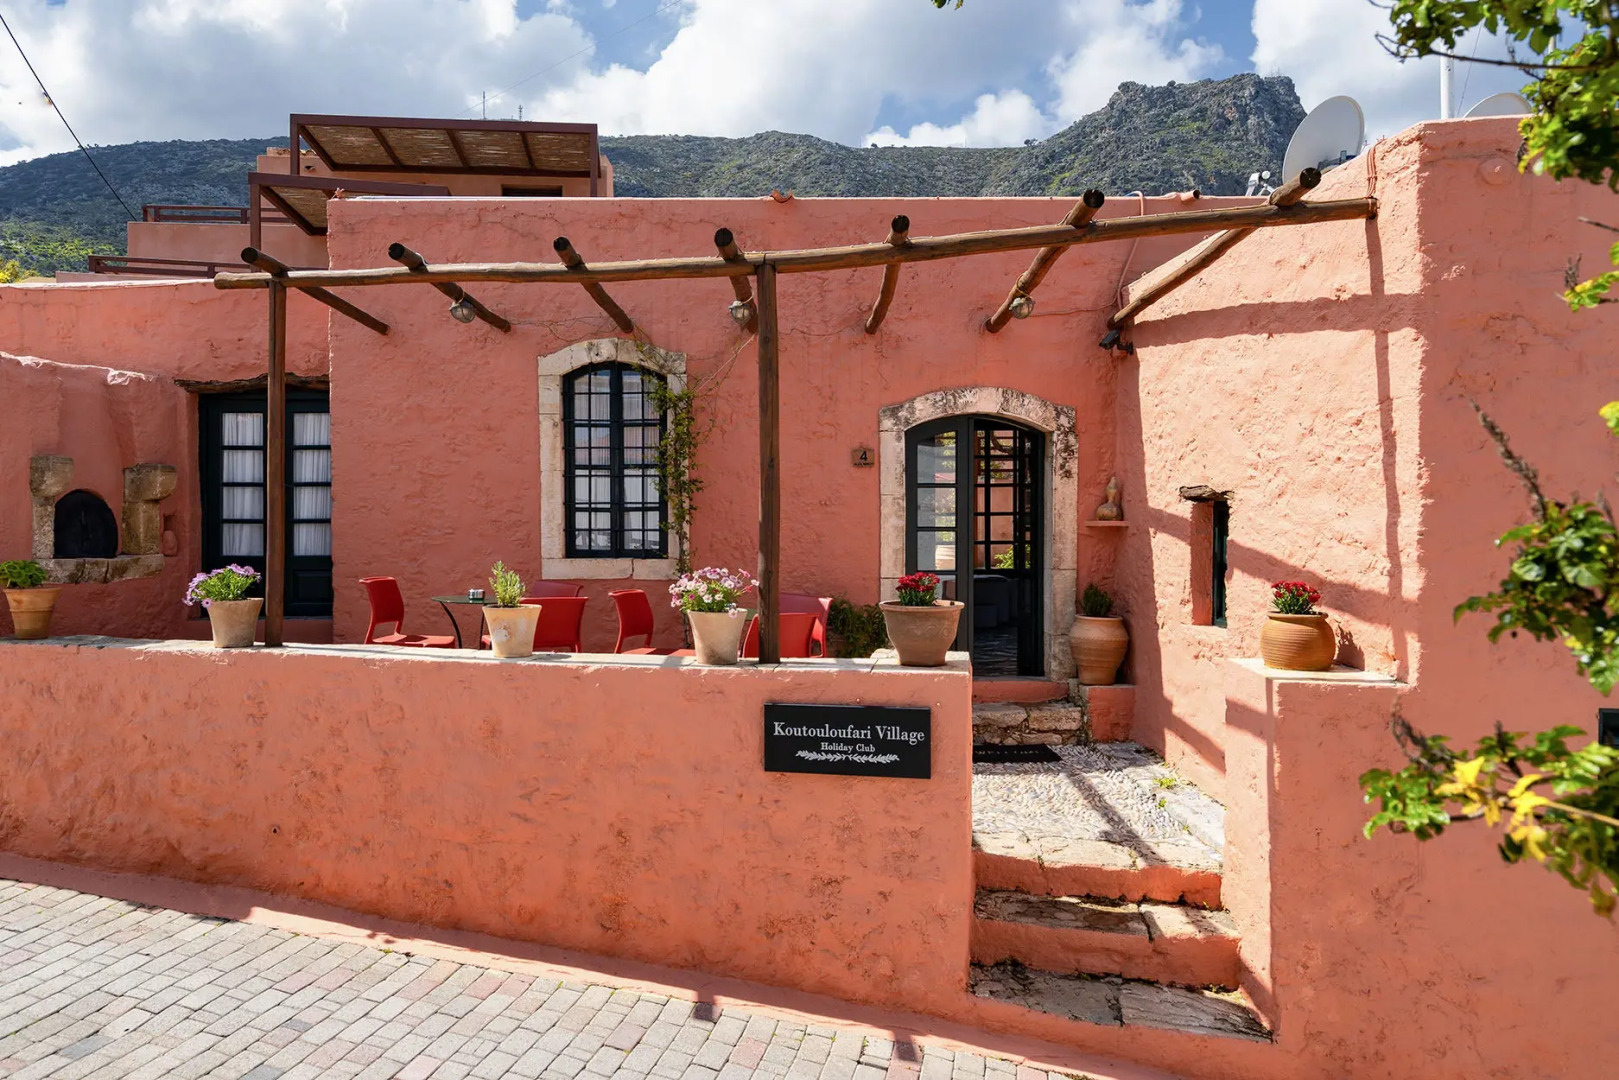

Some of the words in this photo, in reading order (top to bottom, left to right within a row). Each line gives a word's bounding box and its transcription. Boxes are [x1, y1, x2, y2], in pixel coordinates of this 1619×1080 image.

[860, 450, 868, 461] 4
[773, 721, 872, 739] Koutouloufari
[875, 725, 925, 745] Village
[820, 742, 854, 753] Holiday
[855, 743, 876, 753] Club
